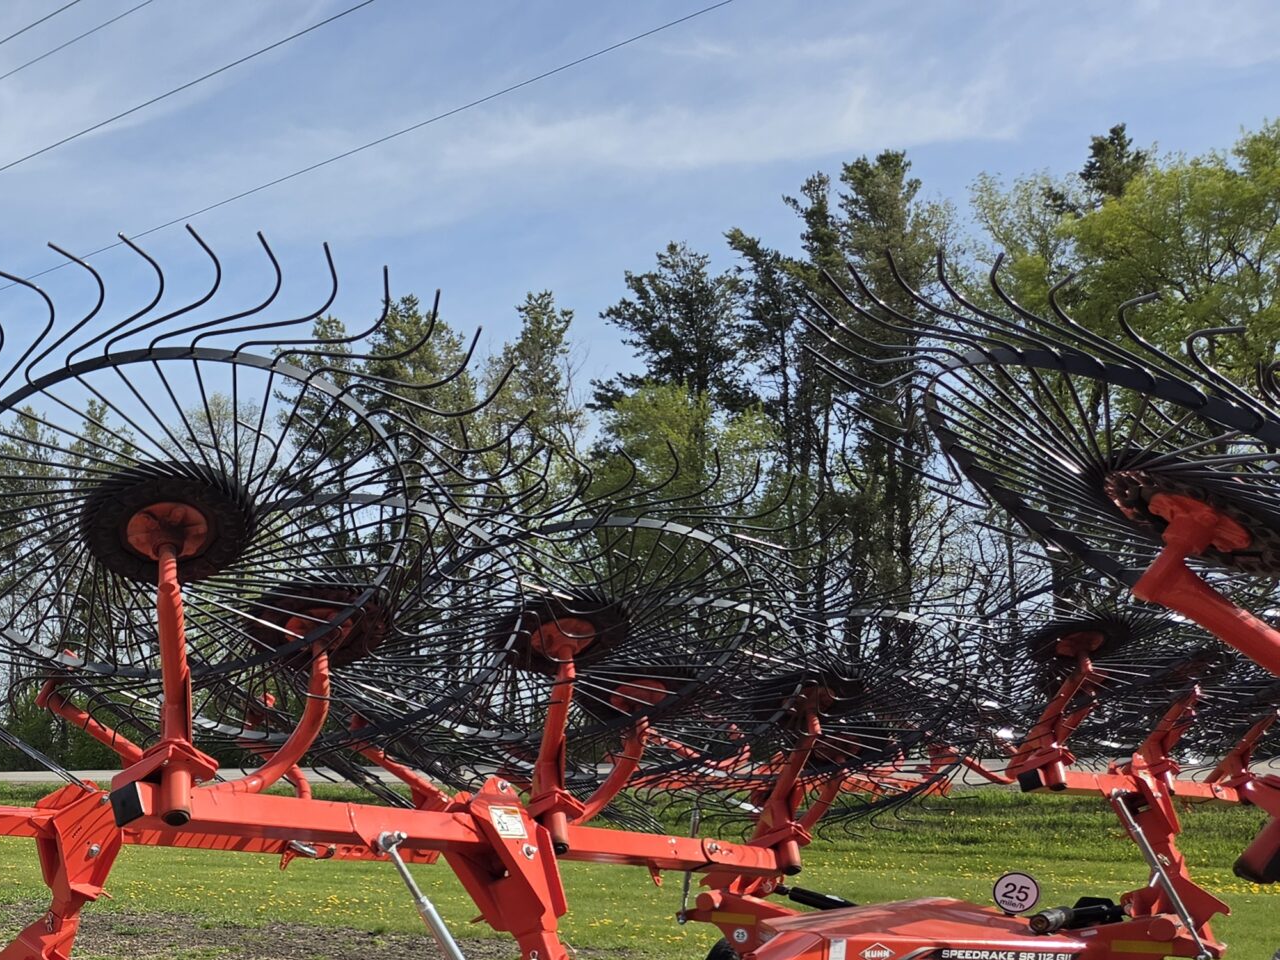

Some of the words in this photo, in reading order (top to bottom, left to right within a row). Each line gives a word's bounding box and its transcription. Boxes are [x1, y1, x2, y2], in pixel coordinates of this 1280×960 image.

[1002, 882, 1030, 902] 25
[1000, 899, 1025, 909] mile/h
[735, 931, 746, 939] 25
[864, 949, 890, 958] KUHN
[941, 949, 1015, 960] SPEEDRAKE
